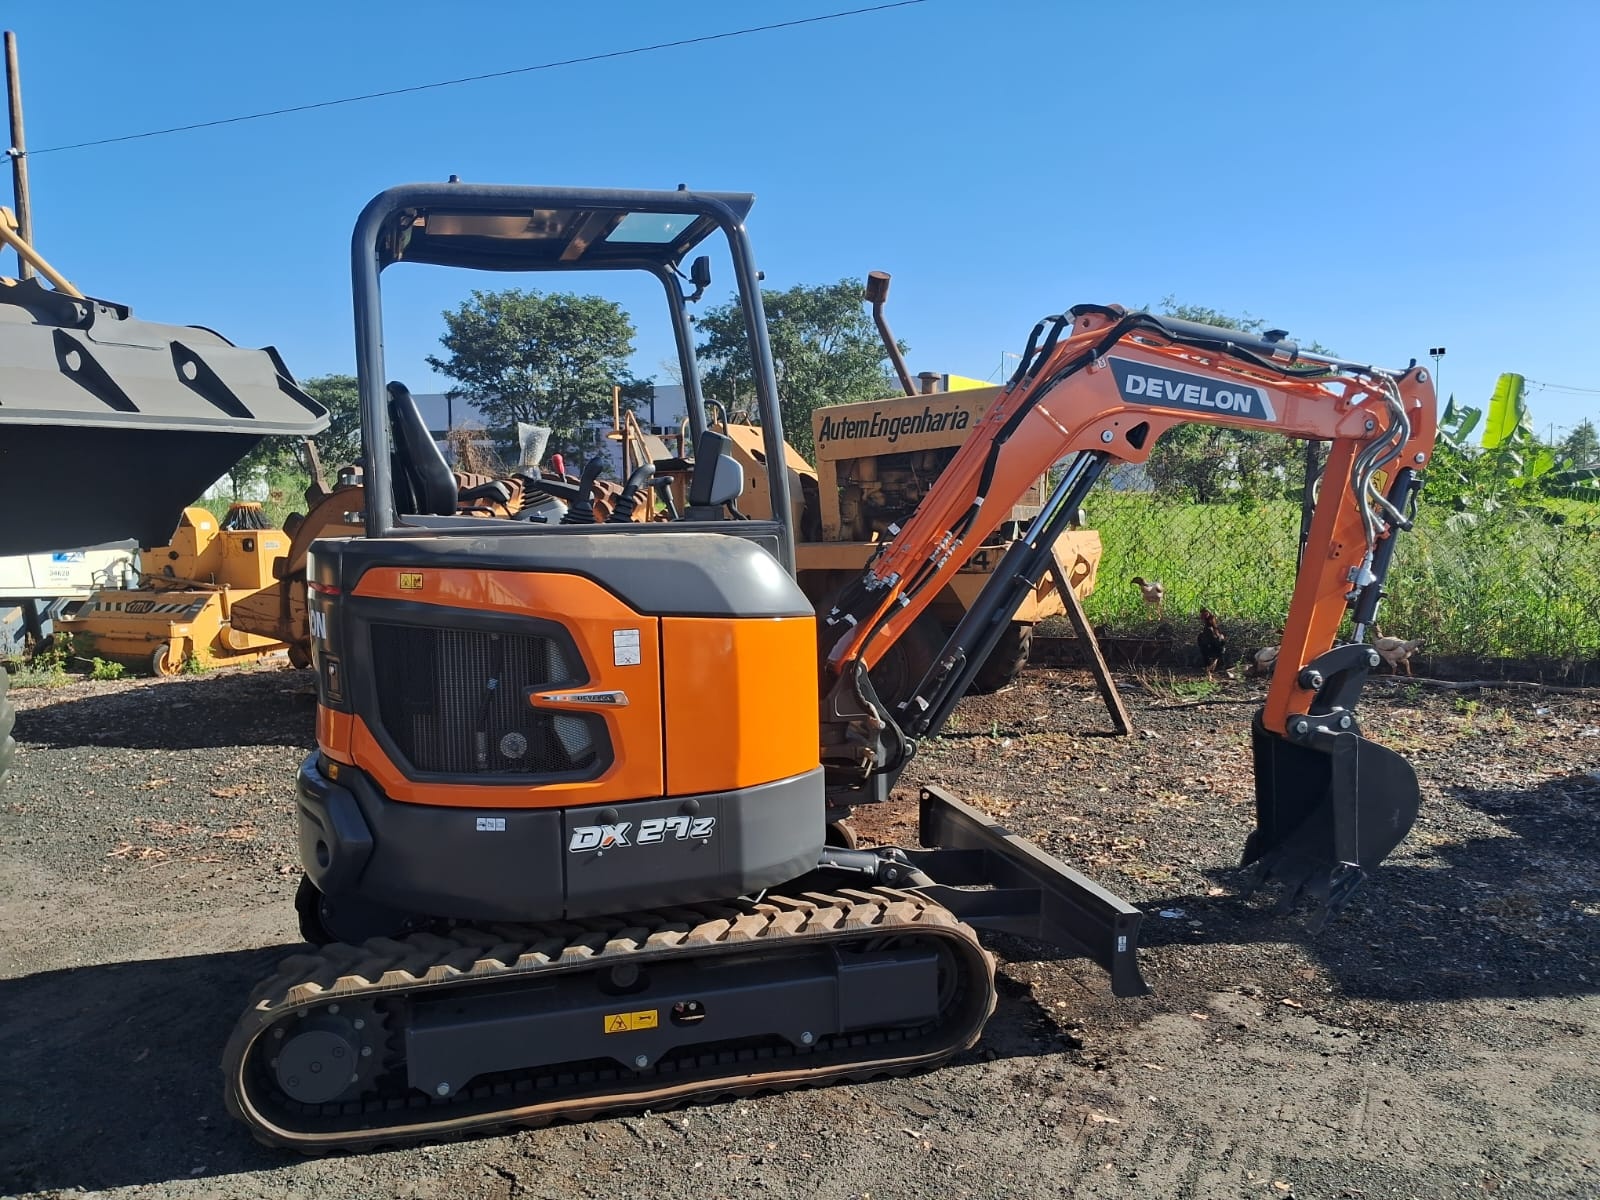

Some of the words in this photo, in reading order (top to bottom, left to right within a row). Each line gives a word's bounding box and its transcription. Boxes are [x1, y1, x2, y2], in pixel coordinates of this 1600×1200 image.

[1125, 374, 1252, 413] DEVELON
[819, 416, 869, 442] Autem
[869, 406, 970, 443] Engenharia
[569, 822, 632, 853] DX
